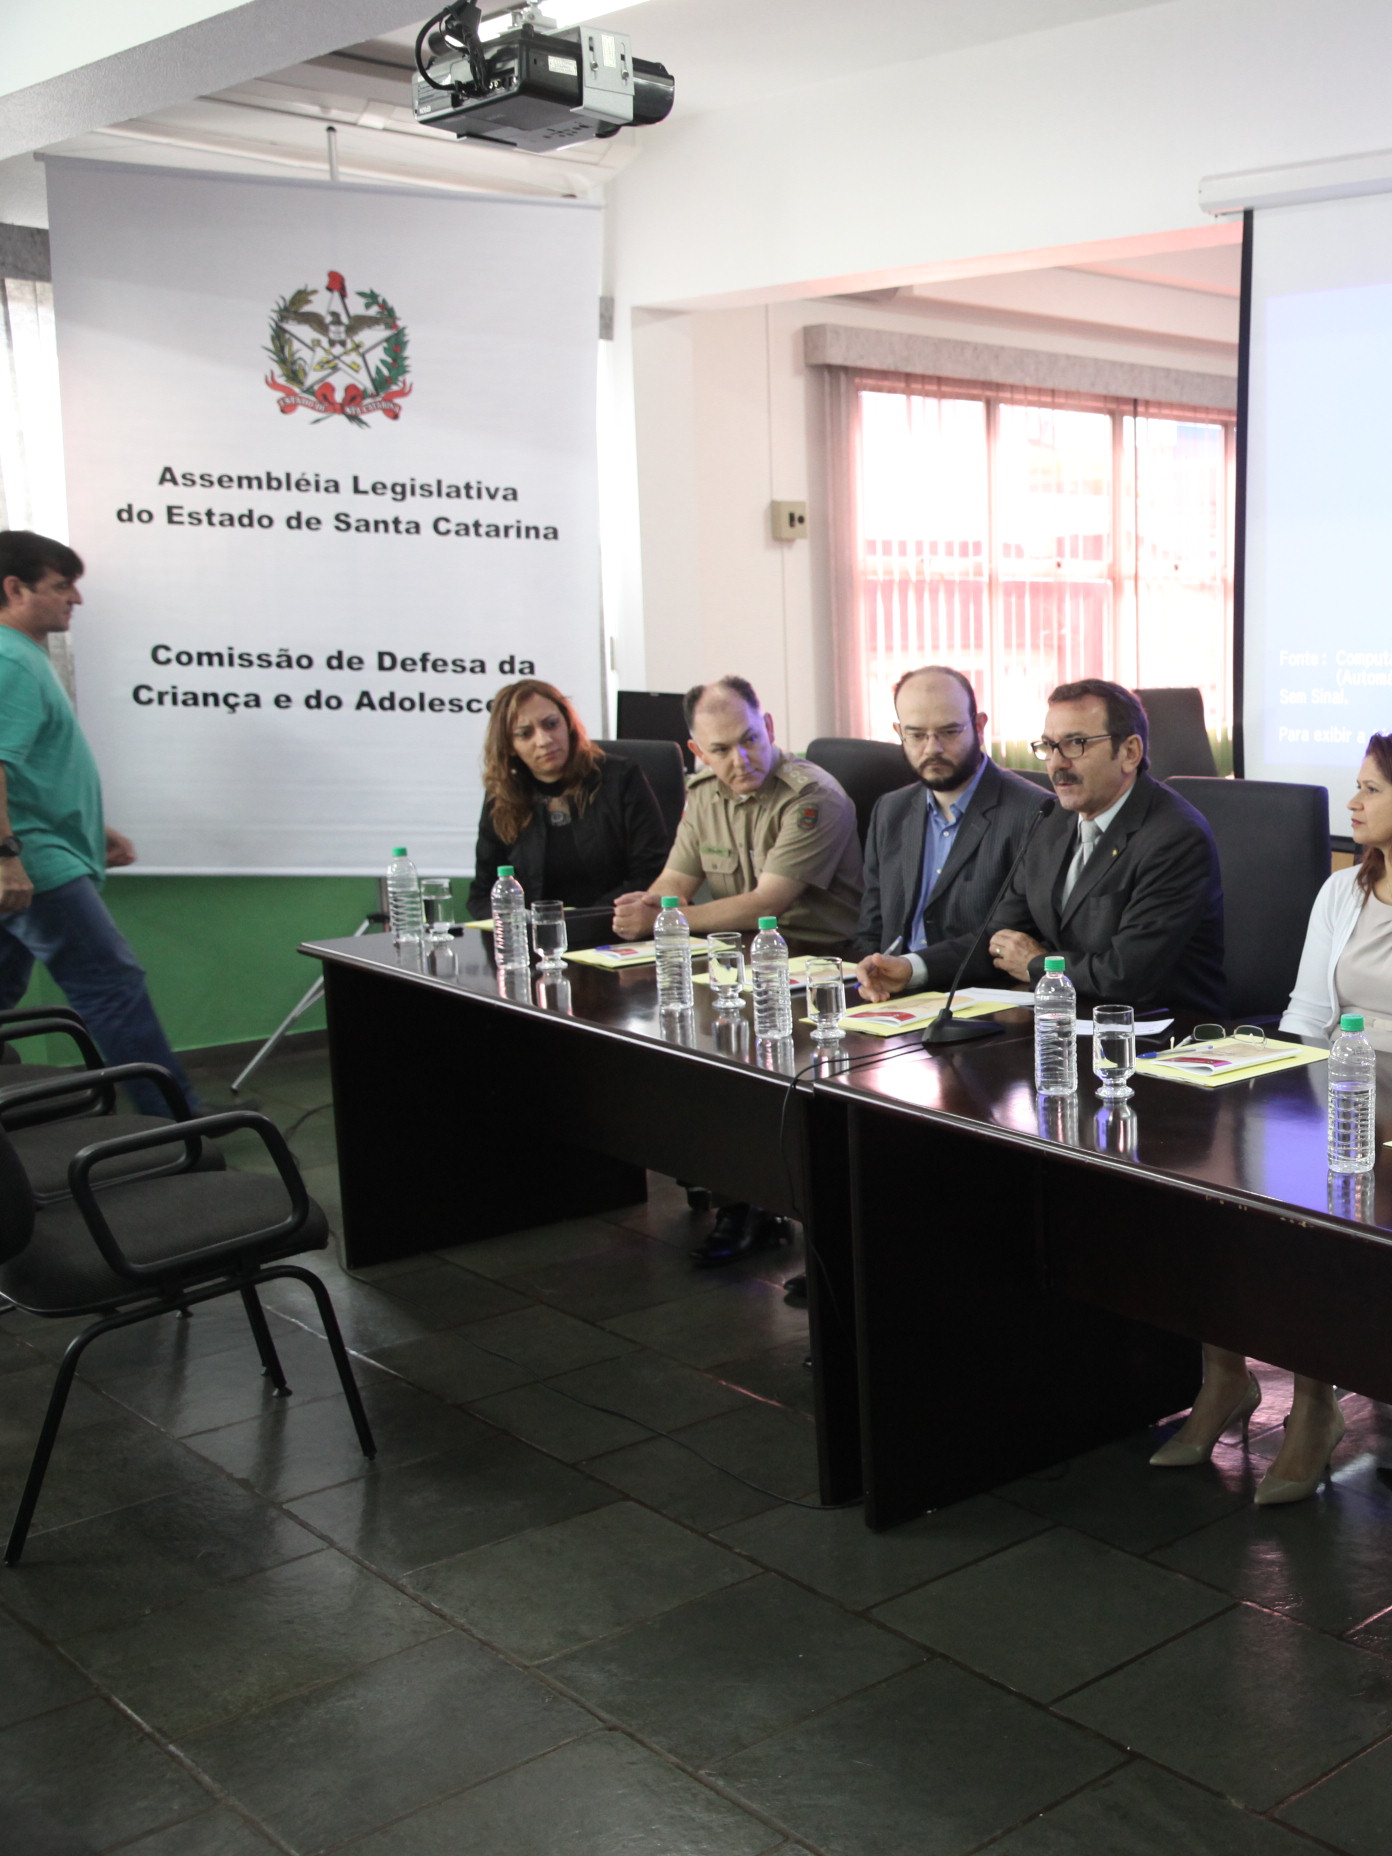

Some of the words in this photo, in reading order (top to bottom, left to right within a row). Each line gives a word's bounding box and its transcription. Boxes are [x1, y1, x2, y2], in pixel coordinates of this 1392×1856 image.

[158, 465, 341, 495] Assembléia
[352, 475, 519, 502] Legislativa
[116, 503, 155, 525] do
[166, 505, 275, 530] Estado
[285, 511, 322, 532] de
[334, 512, 421, 536] Santa
[432, 516, 559, 541] Catarina
[150, 644, 315, 671] Comissão
[326, 649, 366, 673] de
[377, 651, 487, 675] Defesa
[498, 654, 536, 676] da
[132, 684, 263, 714] Criança
[273, 692, 294, 711] e
[304, 689, 344, 711] do
[1279, 688, 1307, 705] Sem
[1311, 688, 1349, 706] Sinal.
[1278, 725, 1310, 743] Para
[1313, 726, 1353, 744] exibir
[1356, 730, 1366, 744] a
